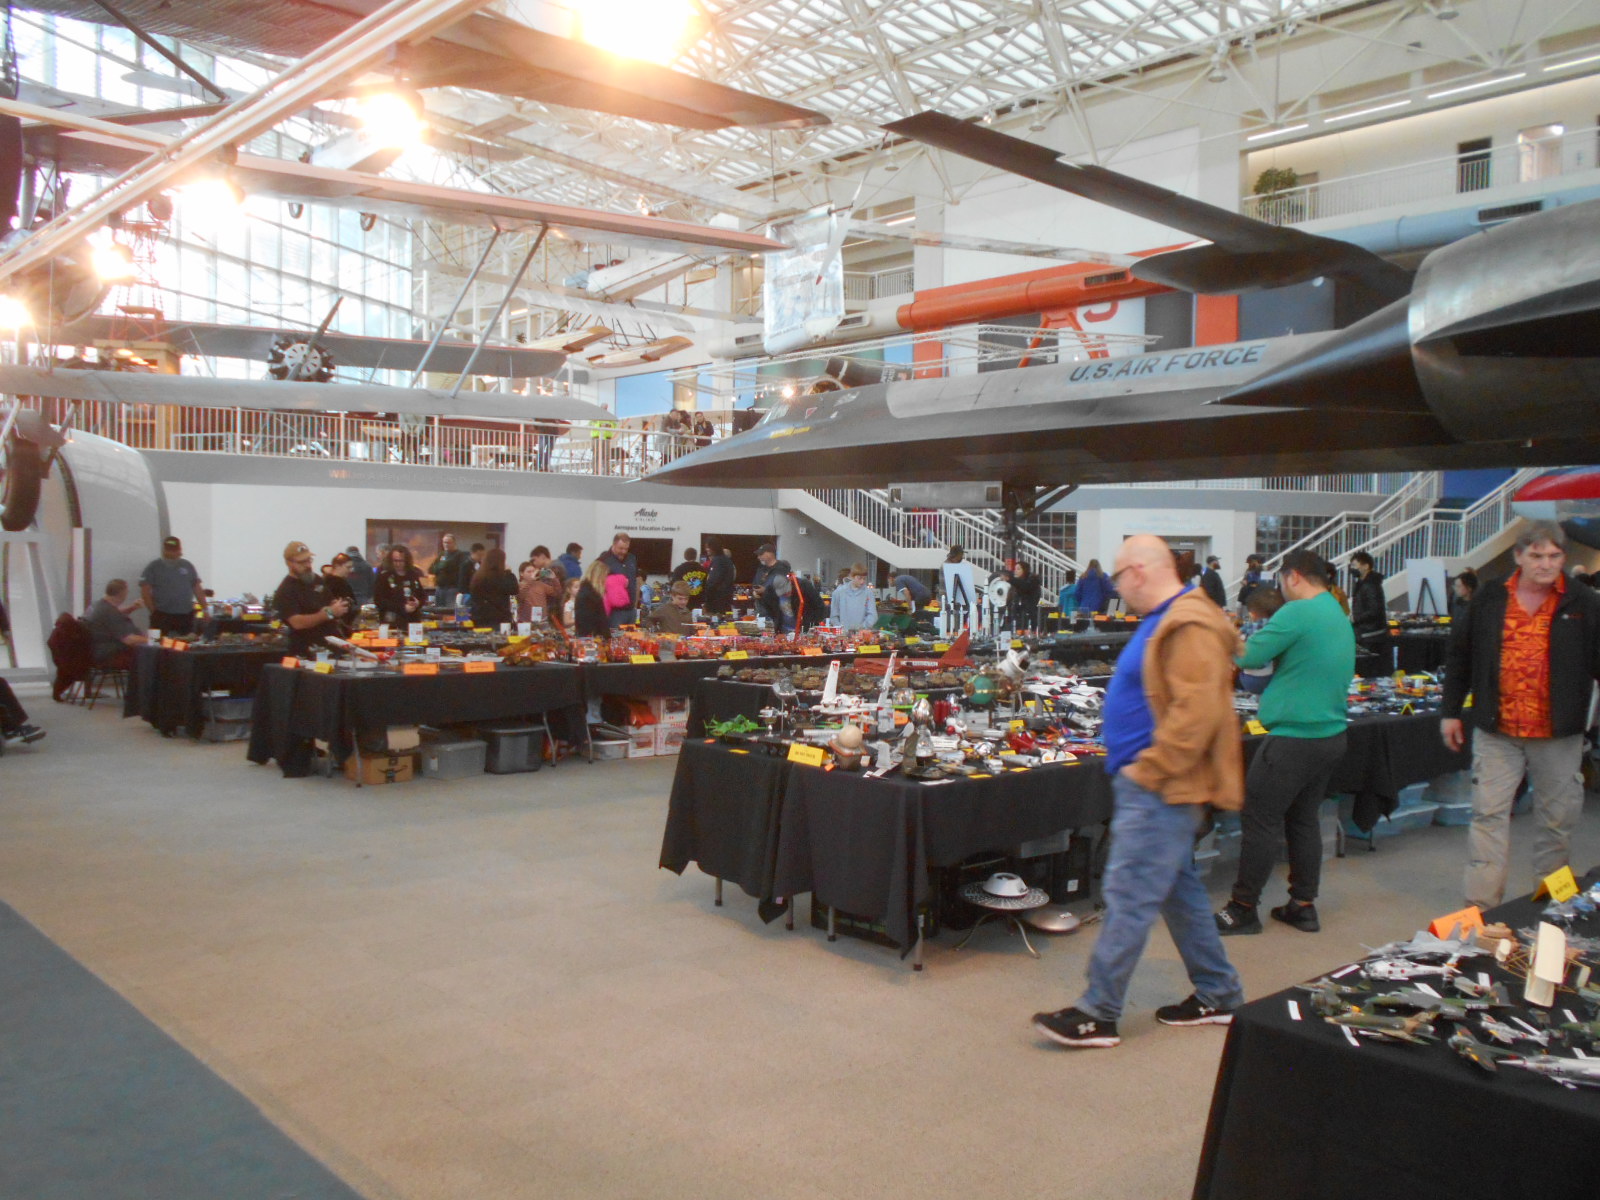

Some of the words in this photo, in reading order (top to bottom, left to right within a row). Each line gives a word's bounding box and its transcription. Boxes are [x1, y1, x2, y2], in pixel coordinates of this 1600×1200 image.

[1069, 362, 1113, 382] U.S.
[1114, 357, 1161, 378] AIR
[1164, 344, 1266, 373] FORCE
[634, 508, 658, 518] Alaska
